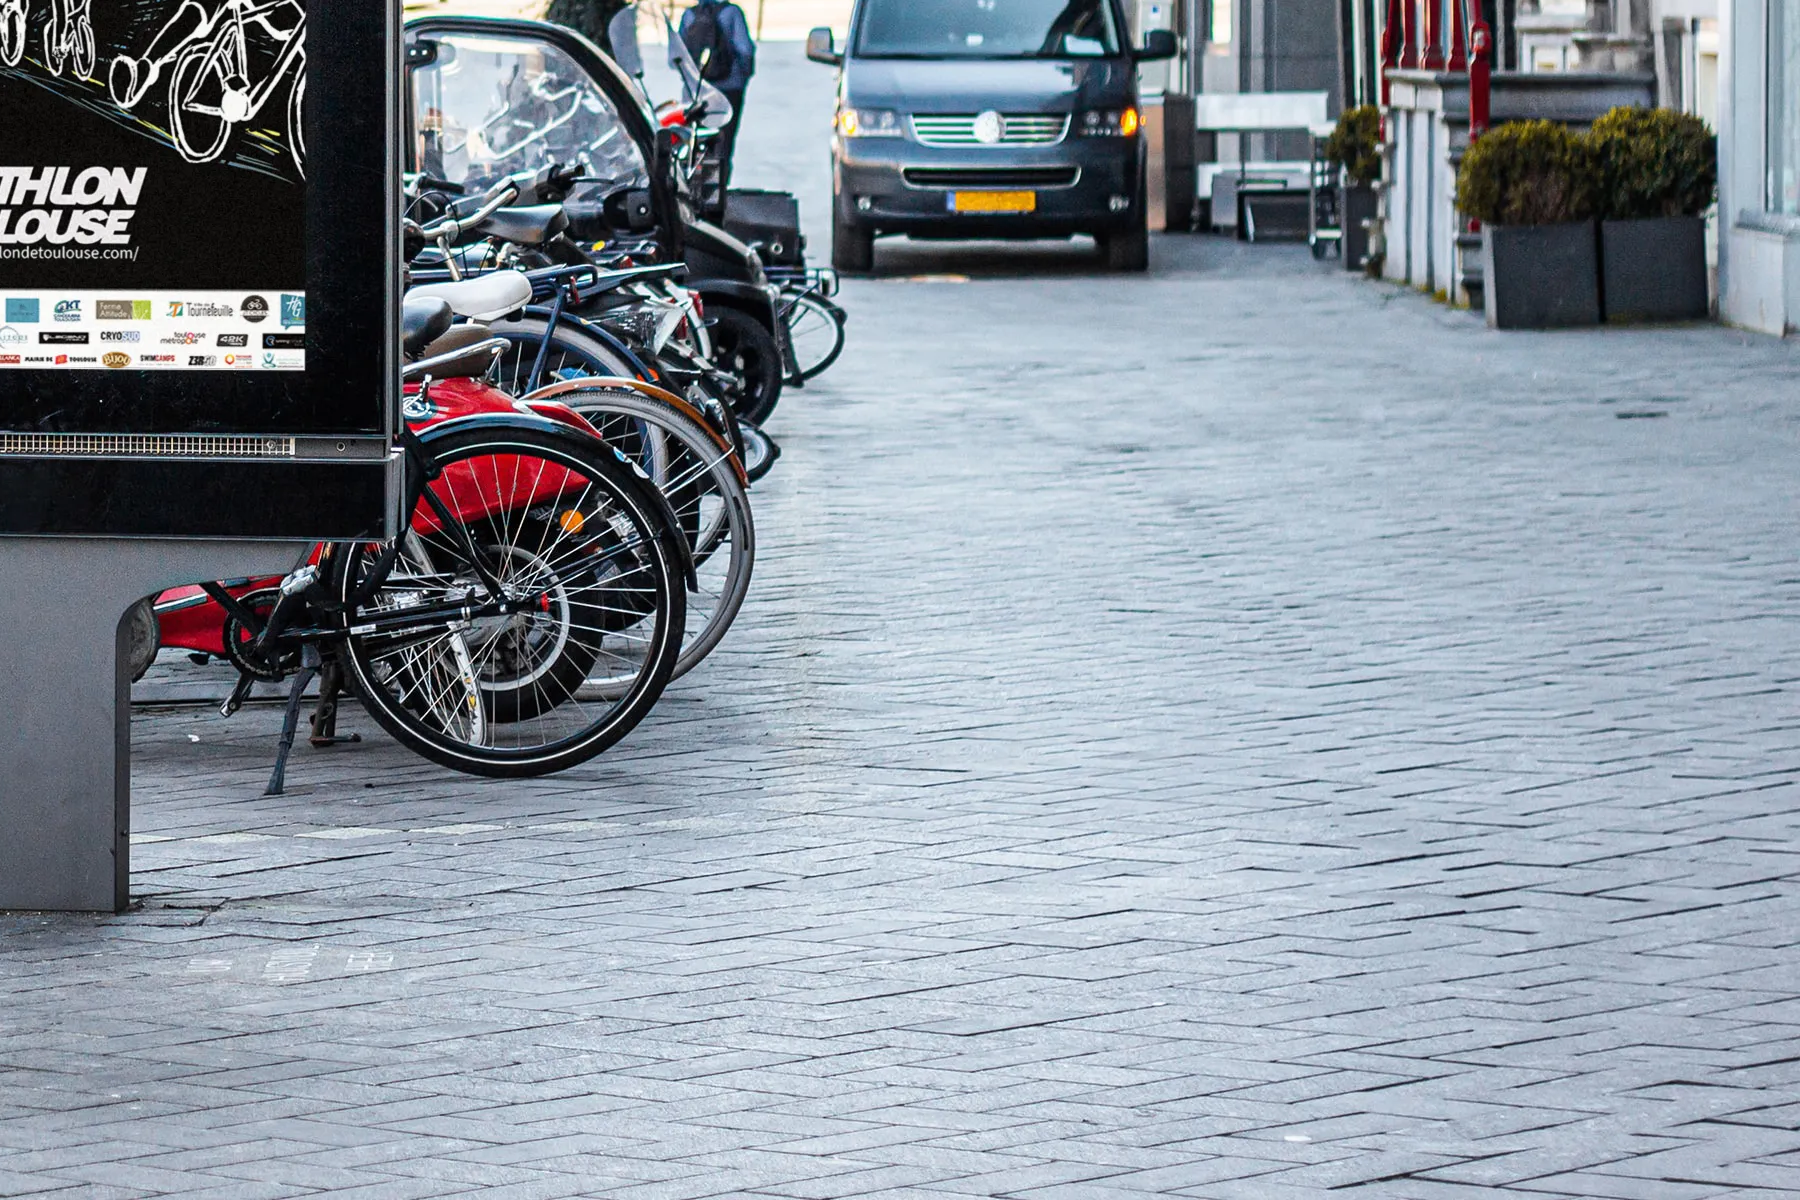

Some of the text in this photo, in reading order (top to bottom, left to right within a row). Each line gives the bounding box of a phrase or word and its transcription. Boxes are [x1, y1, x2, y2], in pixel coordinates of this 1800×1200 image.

[100, 302, 121, 310] Ferme
[186, 302, 233, 317] Tournefeuille
[103, 353, 131, 365] BIJOU
